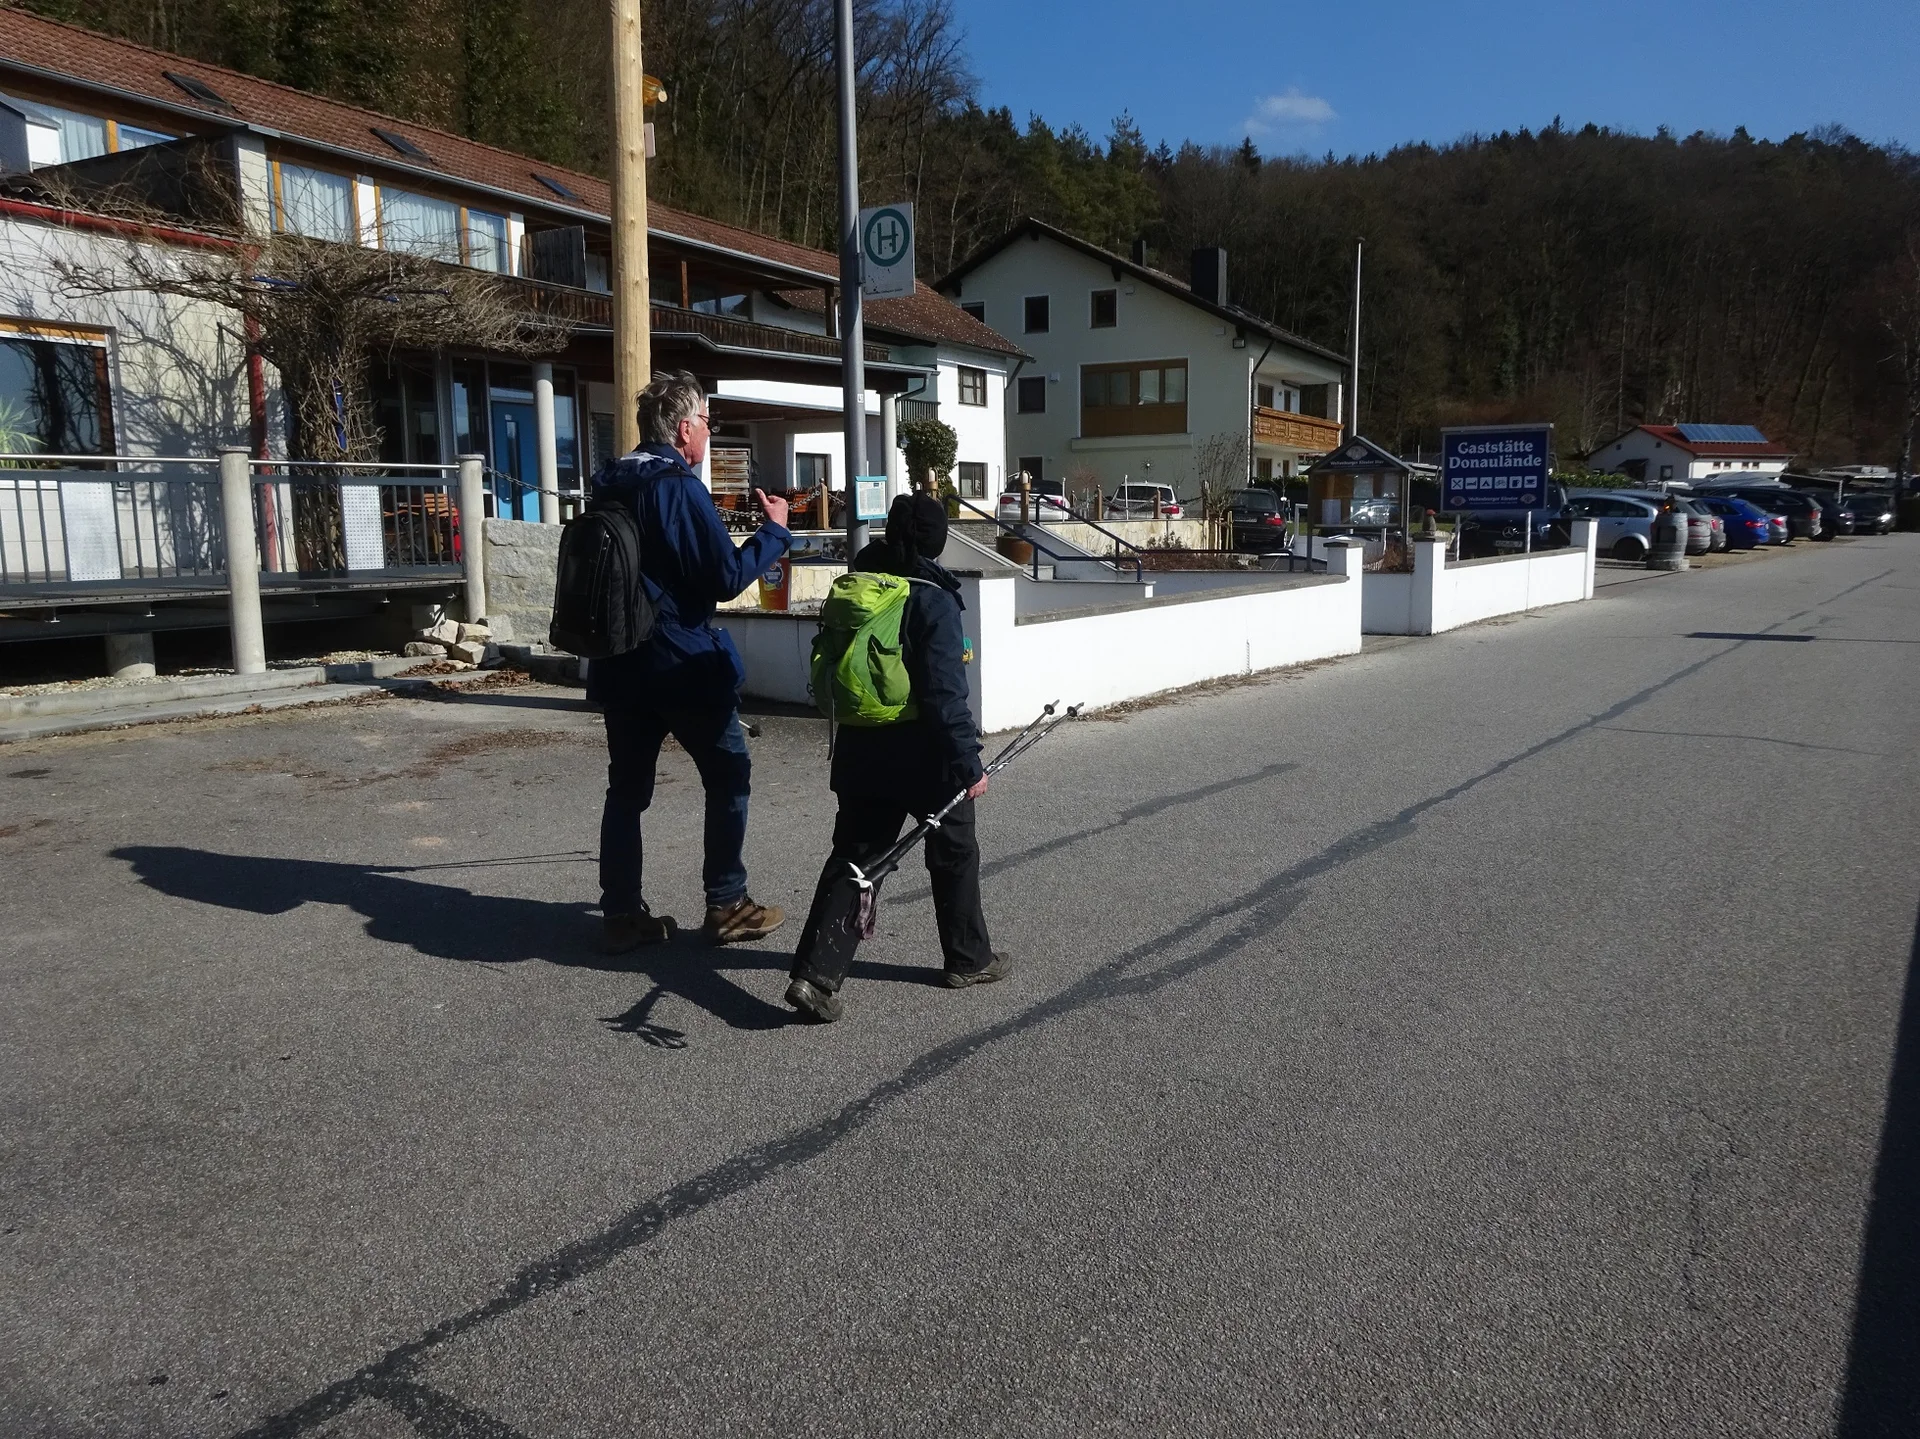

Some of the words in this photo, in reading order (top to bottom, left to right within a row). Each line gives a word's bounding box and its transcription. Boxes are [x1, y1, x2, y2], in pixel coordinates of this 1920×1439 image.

[877, 220, 897, 255] H
[1457, 440, 1533, 455] Gaststätte
[1449, 454, 1542, 469] Donaulände
